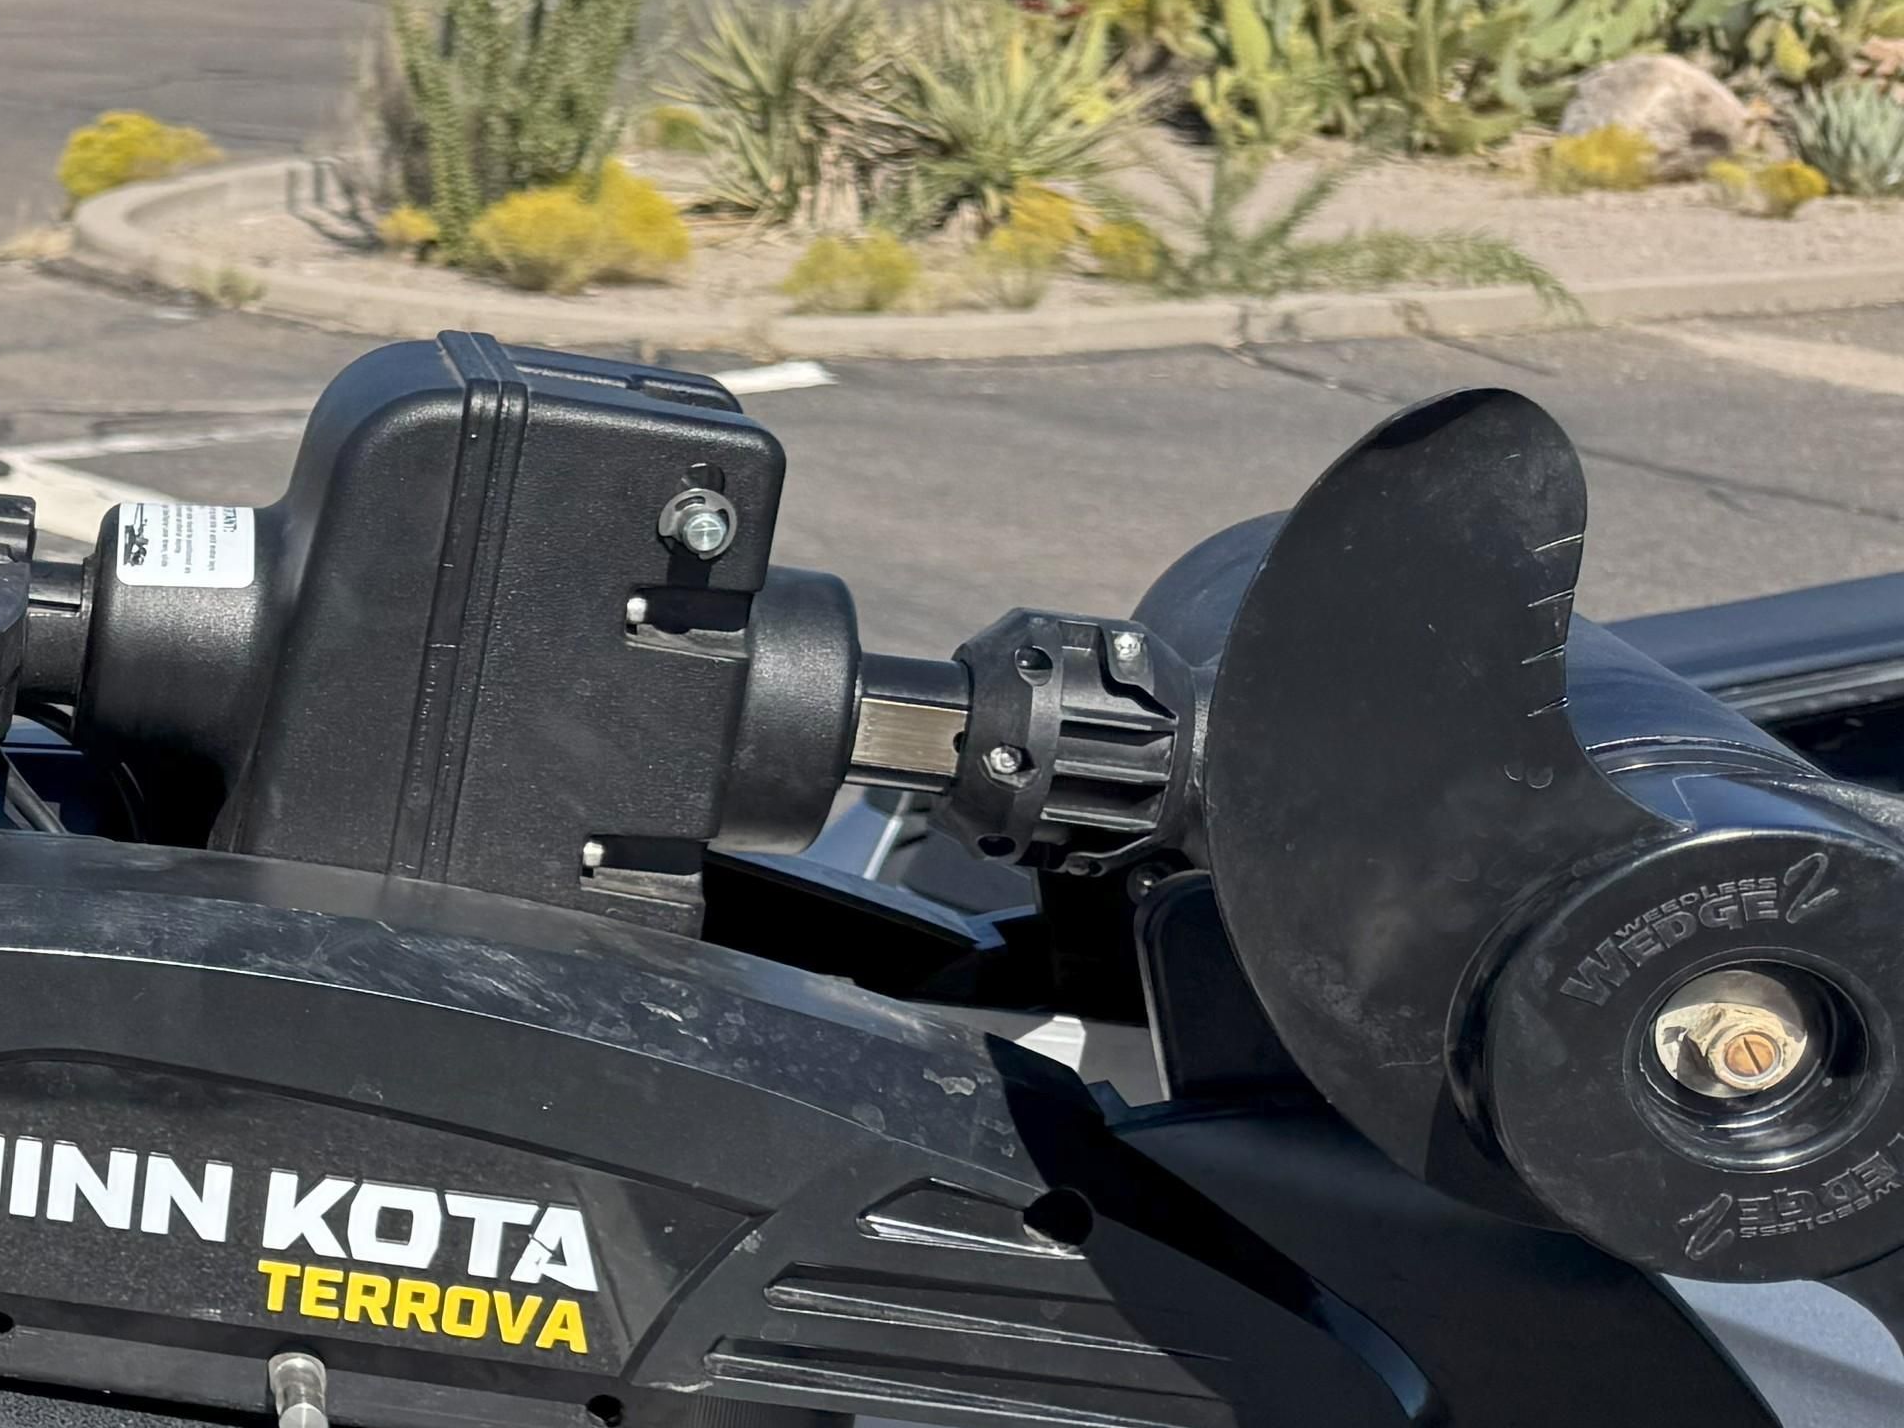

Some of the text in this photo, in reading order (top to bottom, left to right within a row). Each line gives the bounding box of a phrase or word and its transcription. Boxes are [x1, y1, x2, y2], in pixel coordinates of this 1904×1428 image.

[1559, 888, 1779, 1008] WEDGE
[1615, 876, 1778, 939] WEEDLESS
[1738, 1133, 1904, 1224] EDGE
[1739, 1180, 1903, 1239] WEEDLESS
[261, 1168, 599, 1293] KOTA
[257, 1259, 589, 1355] TERROVA
